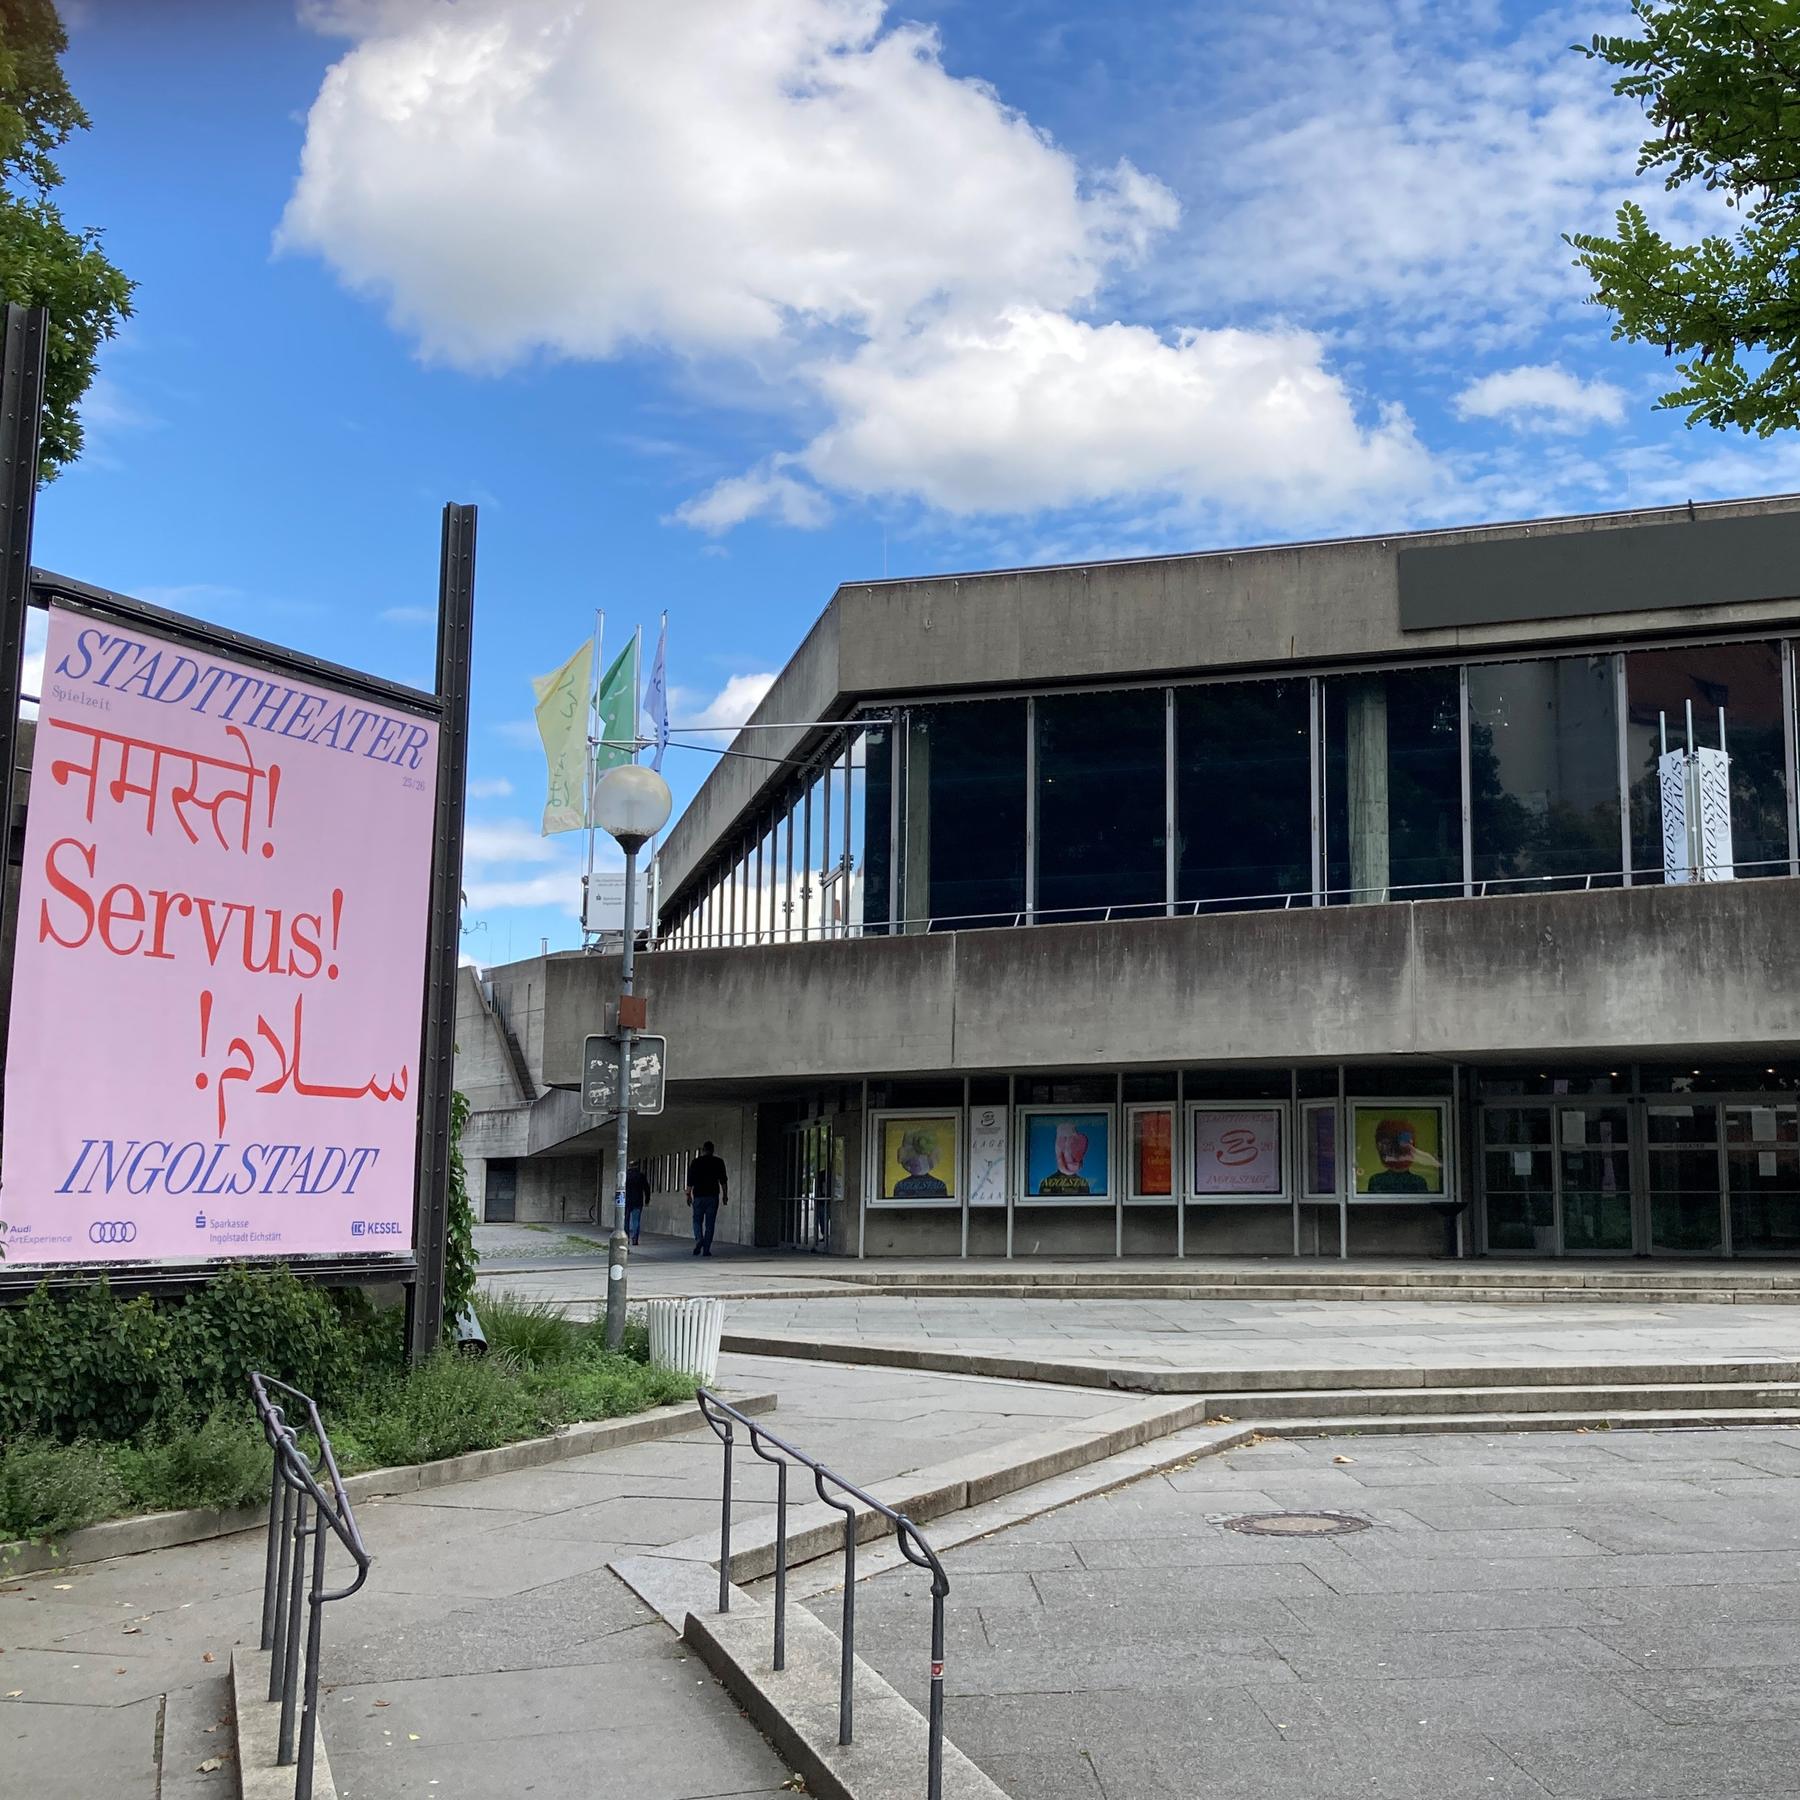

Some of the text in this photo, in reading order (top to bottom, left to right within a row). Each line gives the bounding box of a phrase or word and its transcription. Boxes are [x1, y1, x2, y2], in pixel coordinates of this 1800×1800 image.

[51, 684, 111, 712] Spielzeit
[55, 629, 429, 770] STADTTHEATER
[48, 725, 281, 859] नमस्ते!
[1671, 757, 1685, 827] HAUS
[1714, 753, 1728, 827] HAUS
[39, 838, 344, 980] Servus!
[54, 1139, 380, 1195] INGOLSTADT
[9, 1235, 72, 1245] ArtExperience
[10, 1225, 31, 1233] Audi
[210, 1219, 249, 1231] Sparkasse
[210, 1232, 248, 1244] Ingolstadt
[367, 1222, 402, 1234] KESSEL
